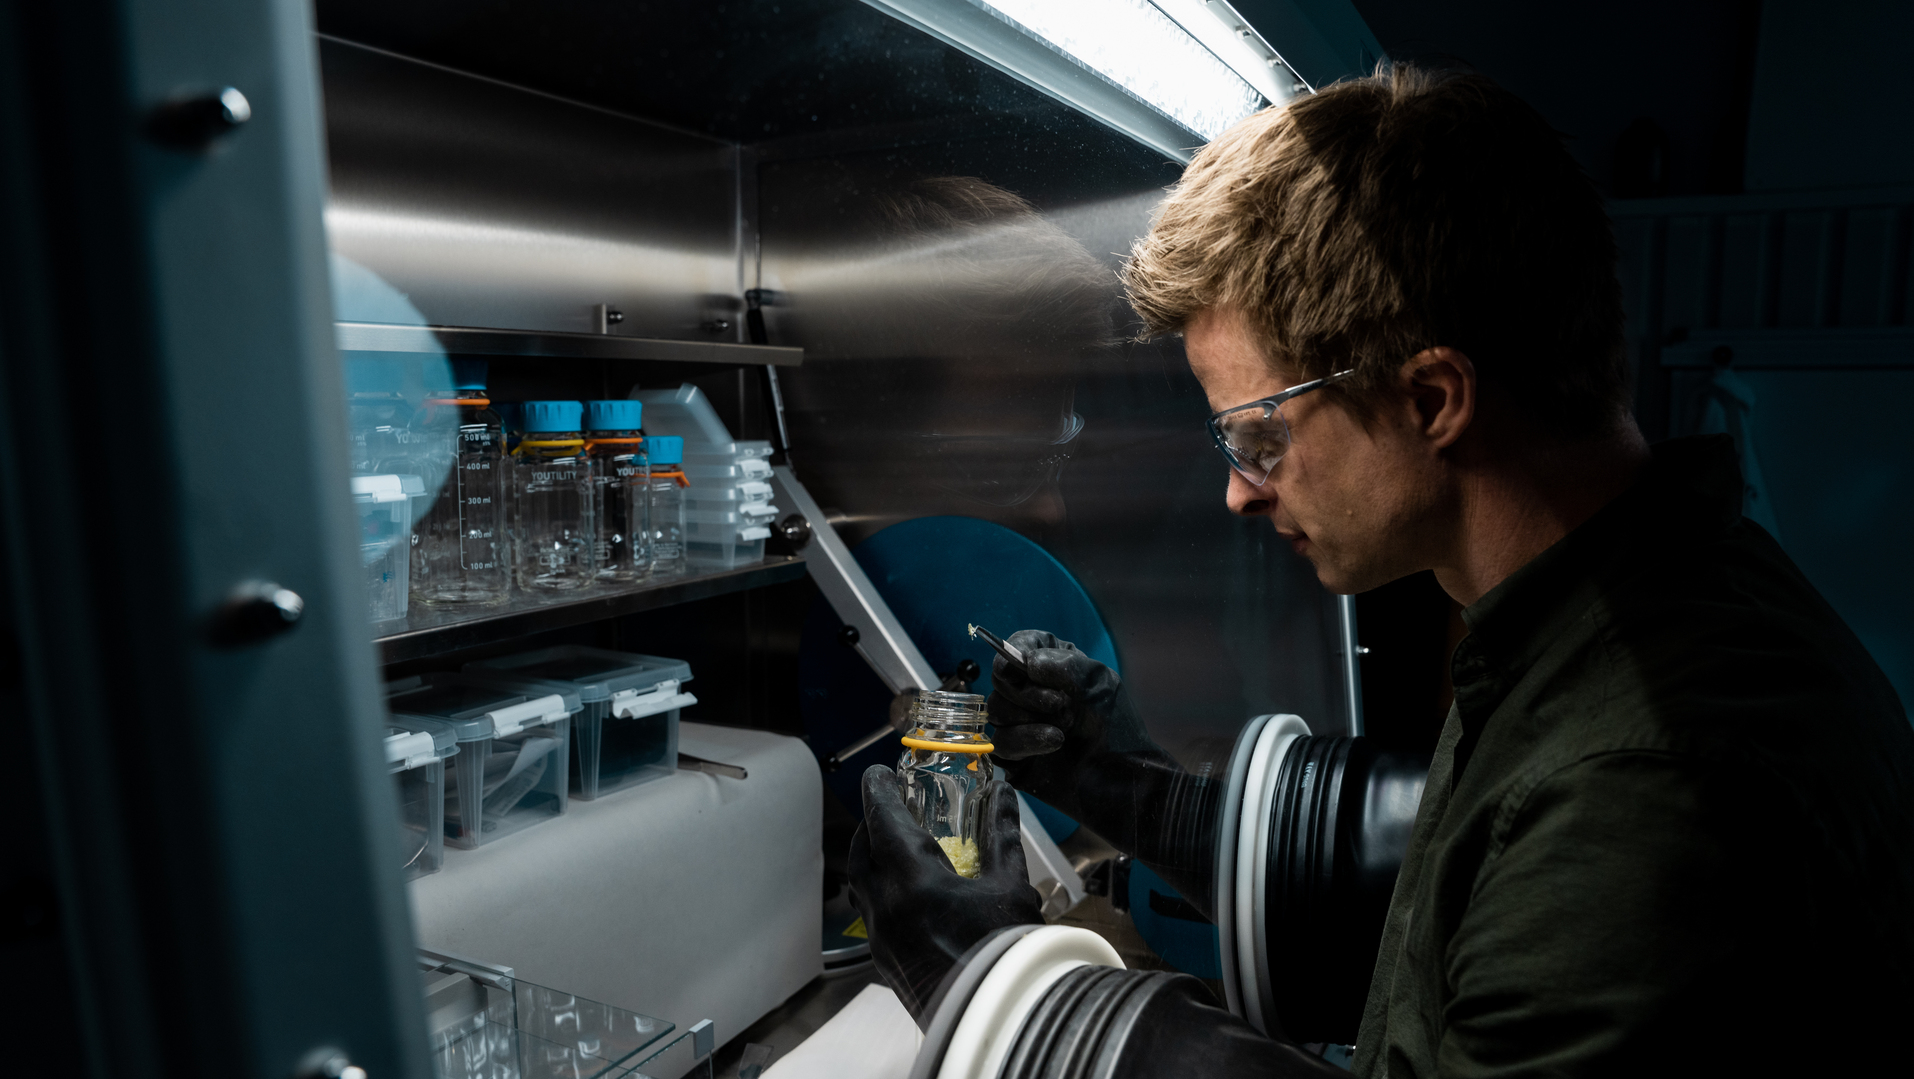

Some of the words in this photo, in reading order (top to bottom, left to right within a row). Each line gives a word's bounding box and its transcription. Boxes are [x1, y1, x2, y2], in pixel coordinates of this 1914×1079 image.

[466, 462, 481, 470] 400
[481, 462, 490, 470] ml
[531, 471, 577, 481] YOUTILITY
[467, 497, 482, 505] 300
[469, 531, 482, 539] 200
[470, 562, 484, 570] 100
